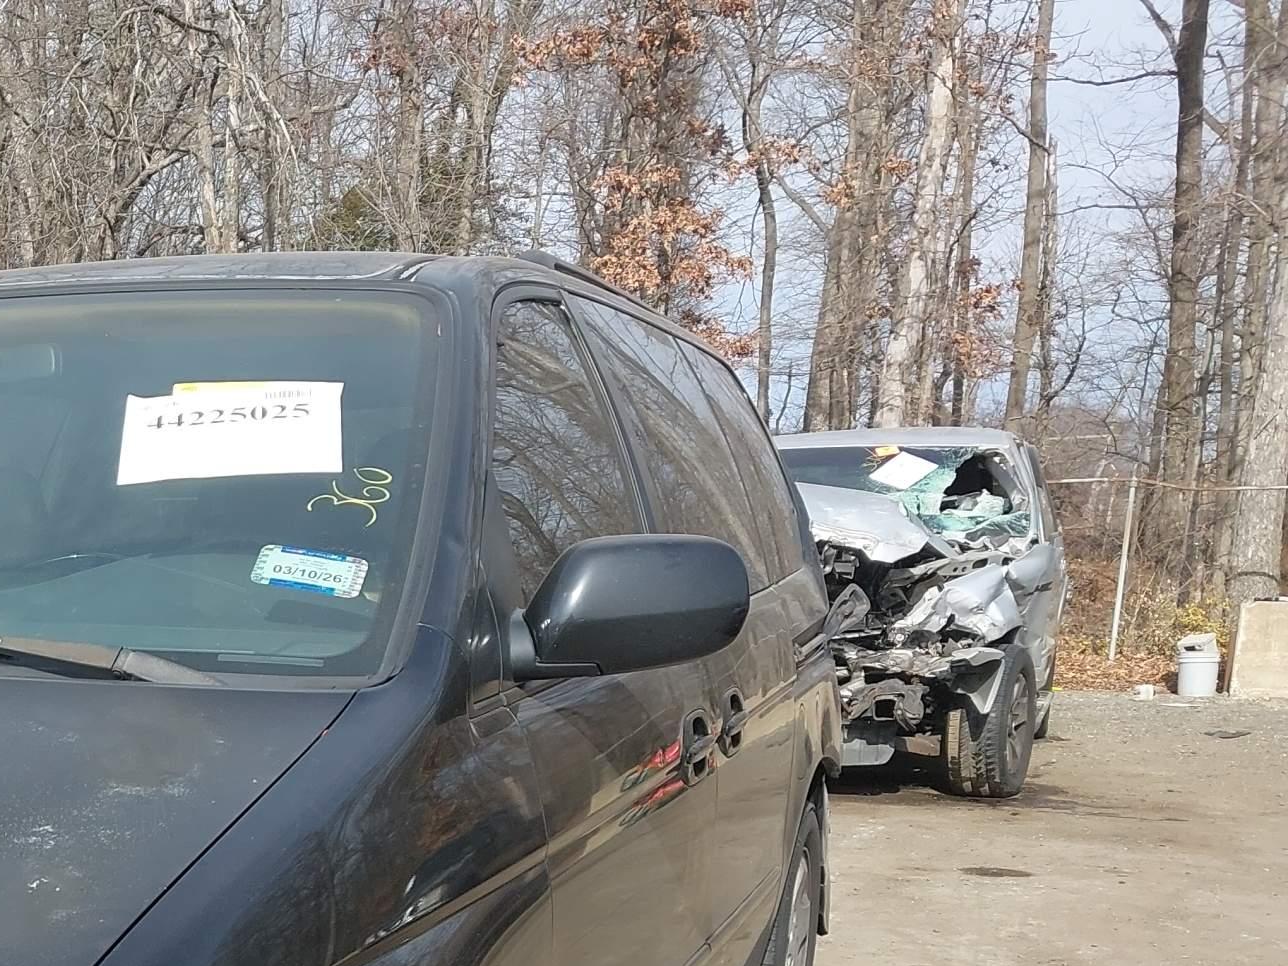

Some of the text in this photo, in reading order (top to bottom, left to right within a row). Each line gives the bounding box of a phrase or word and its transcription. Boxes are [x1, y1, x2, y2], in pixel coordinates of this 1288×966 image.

[147, 402, 311, 430] 44225025
[306, 466, 393, 528] 360
[272, 564, 344, 584] 03/10/26
